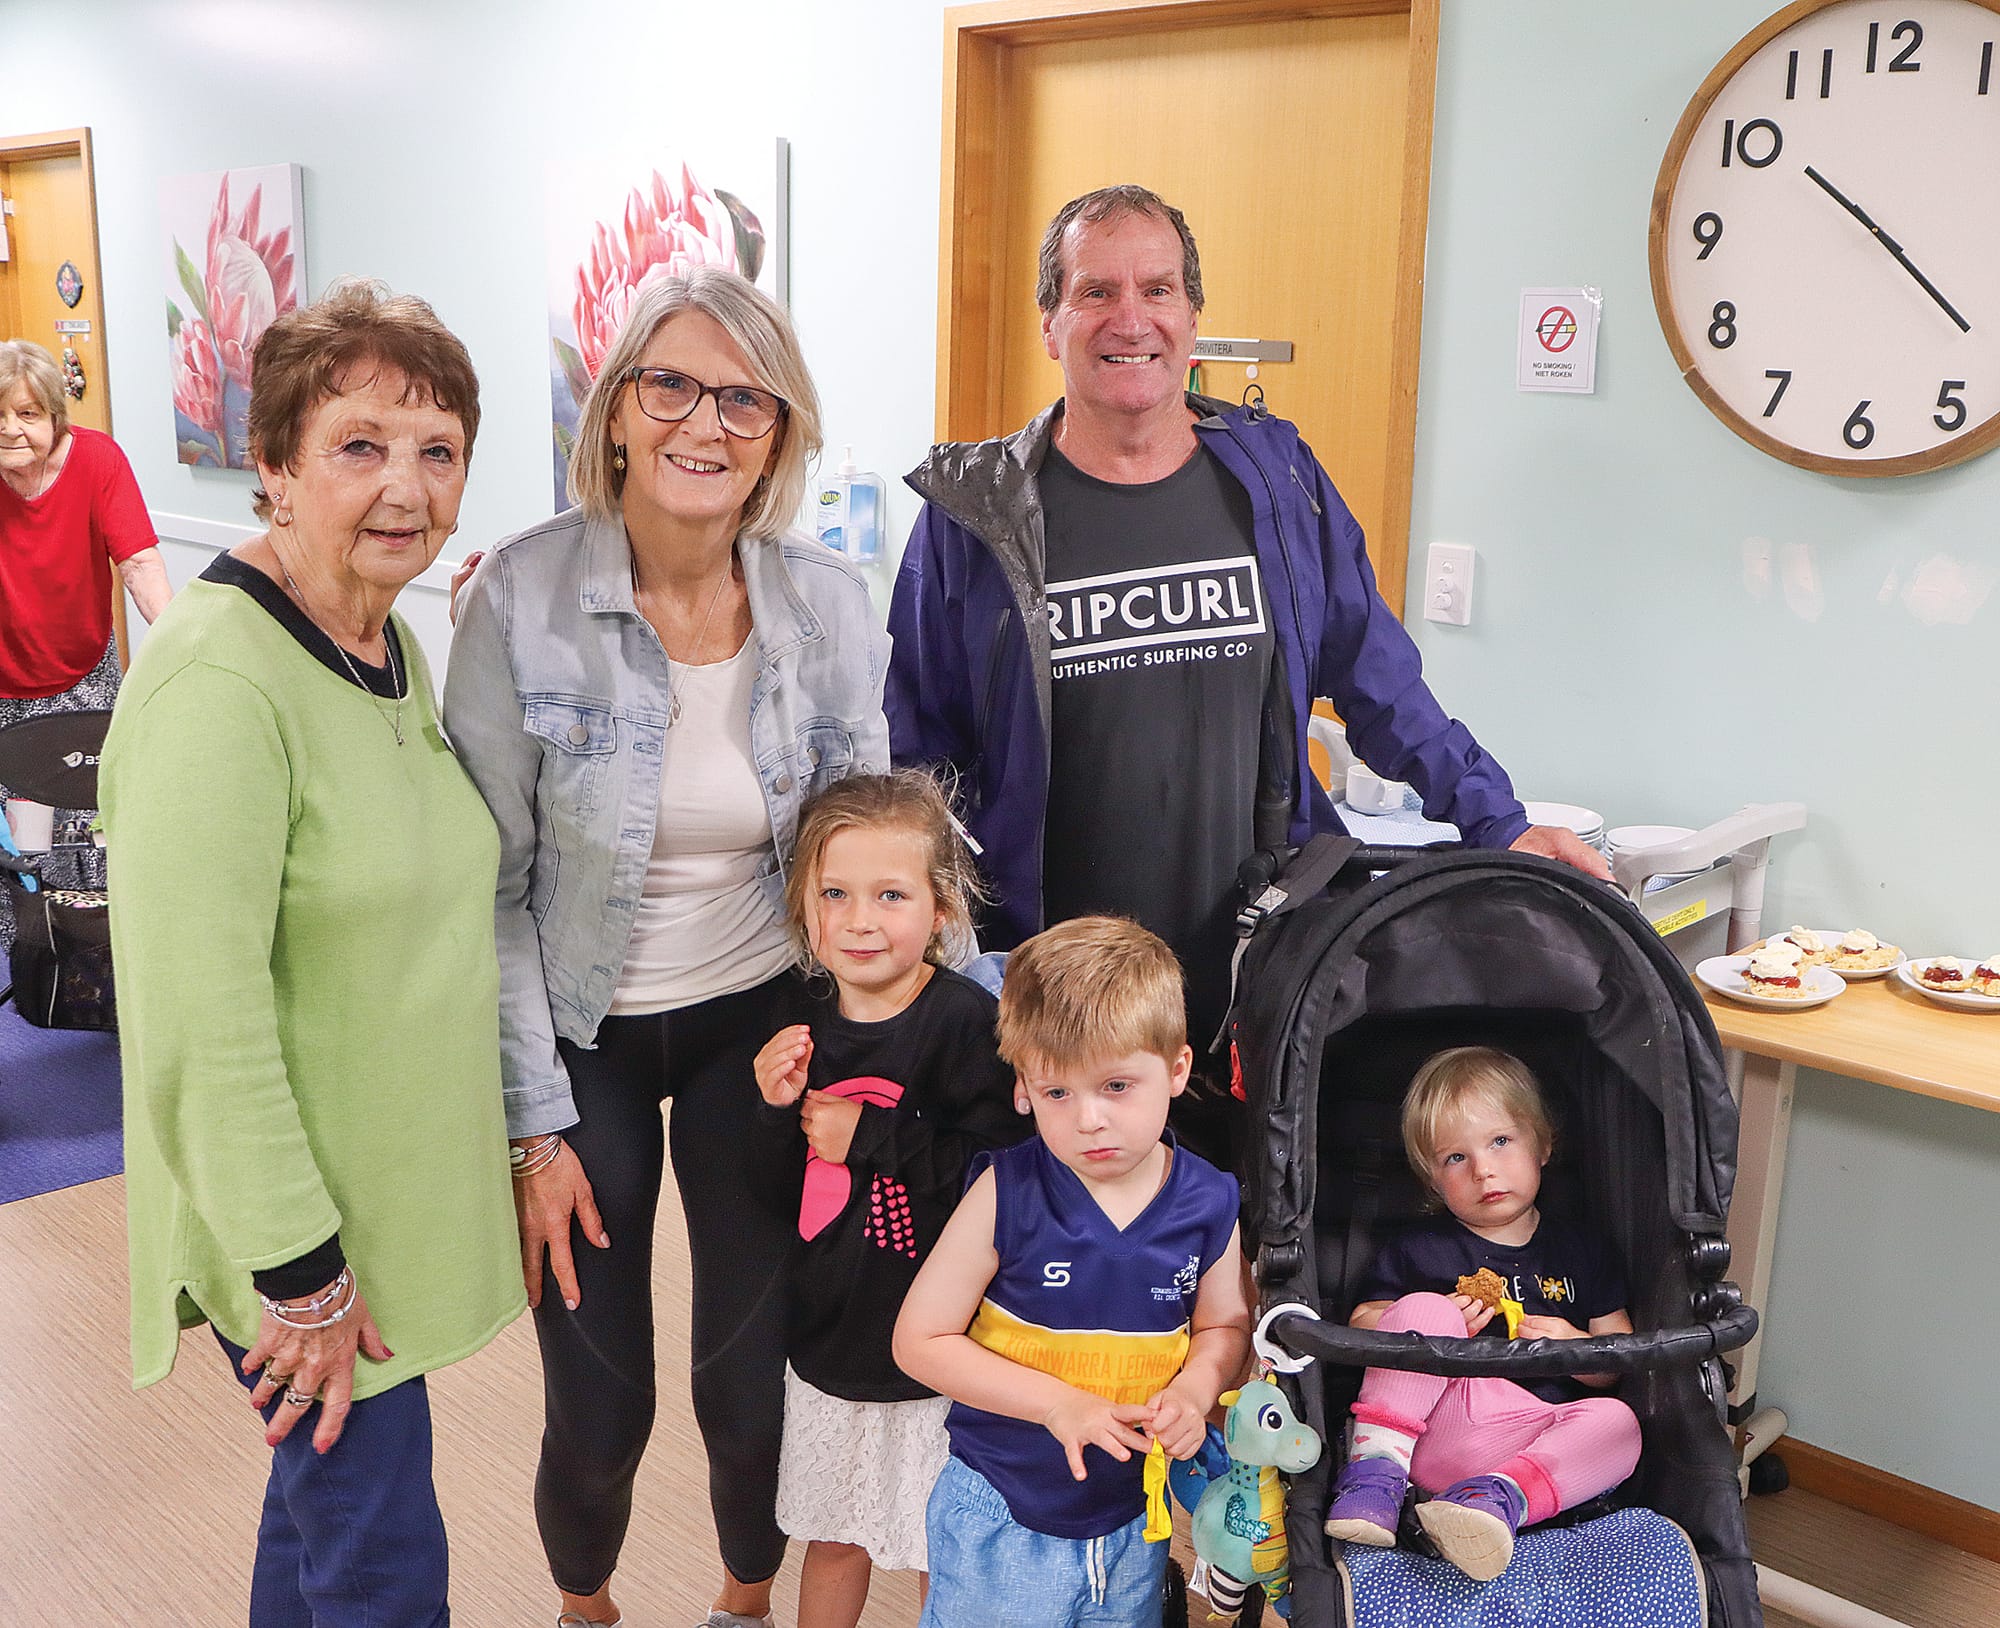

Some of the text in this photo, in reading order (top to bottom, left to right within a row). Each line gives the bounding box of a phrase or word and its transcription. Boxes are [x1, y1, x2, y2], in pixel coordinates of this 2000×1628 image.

[1866, 20, 1923, 73] 12
[1978, 42, 1993, 95] 1
[1785, 48, 1833, 100] 11
[1721, 118, 1784, 168] 10
[1692, 211, 1723, 260] 9
[1194, 343, 1233, 355] PRIVITERA
[1707, 300, 1737, 349] 8
[1762, 369, 1793, 417] 7
[1933, 380, 1966, 431] 5
[1843, 400, 1875, 449] 6
[1047, 575, 1251, 642] RIPCURL
[1051, 653, 1137, 681] UTHENTIC
[1143, 645, 1218, 666] SURFING
[1500, 1274, 1525, 1301] RE
